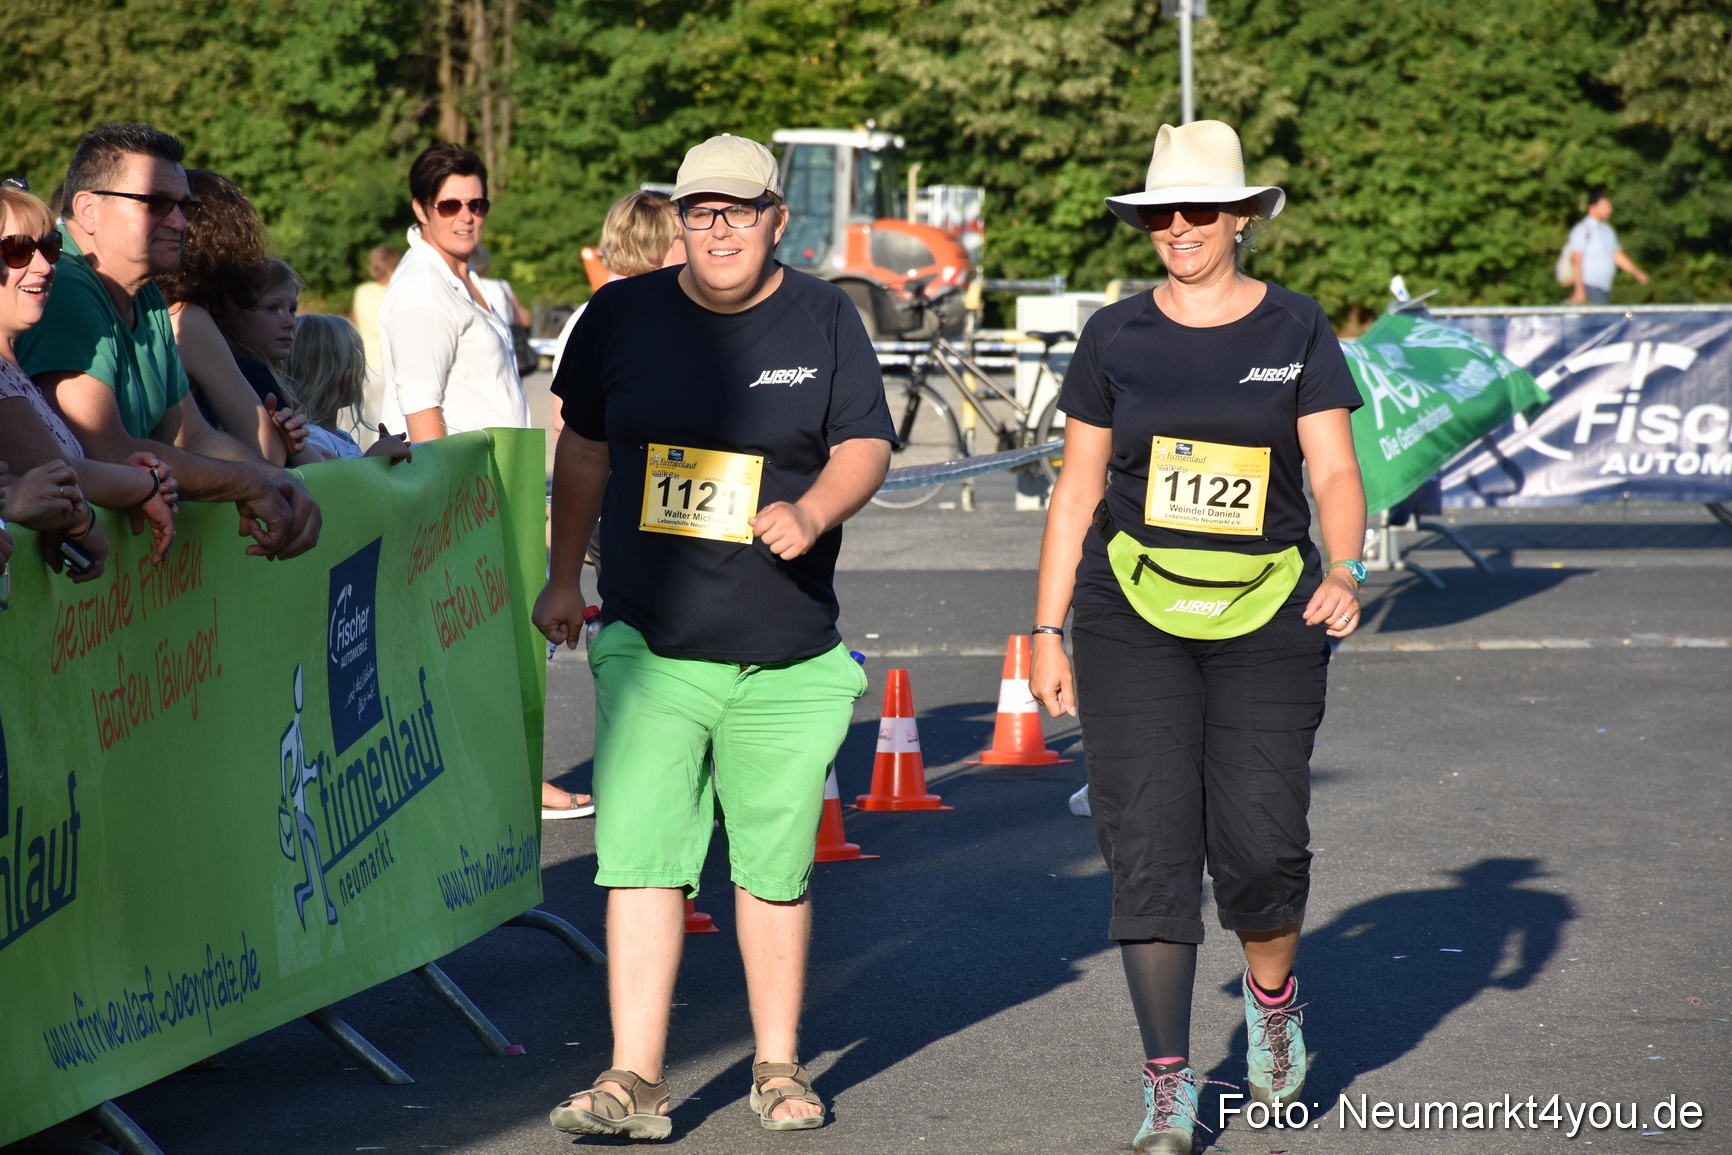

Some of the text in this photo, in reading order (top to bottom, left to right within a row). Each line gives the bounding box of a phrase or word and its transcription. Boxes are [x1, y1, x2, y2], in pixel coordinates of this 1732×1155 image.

[749, 369, 798, 388] JURA
[1239, 366, 1290, 385] JURA
[1574, 391, 1732, 445] Fisc
[660, 457, 698, 470] firmenlauf
[1166, 451, 1208, 465] firmenlauf
[1379, 436, 1401, 462] Die
[657, 476, 737, 516] 1121
[1164, 470, 1252, 510] 1122
[657, 517, 689, 527] Lebenshilfe
[664, 509, 727, 524] Walter Michel
[1164, 512, 1200, 523] Lebenshilfe
[1200, 517, 1230, 526] Neumarkt
[1230, 519, 1243, 527] e.V.
[1169, 503, 1241, 519] Weindel Daniela
[51, 540, 203, 676] Gesunde Firmen
[430, 569, 487, 653] laufen
[1164, 599, 1217, 615] JURA
[336, 606, 370, 652] Fischer
[340, 637, 368, 670] AUTOMOBILE
[91, 596, 222, 754] laufen länger!
[317, 665, 442, 862] firmenlauf
[338, 829, 395, 908] neumarkt
[42, 929, 261, 1073] www.firmenlauf-oberpfalz.de
